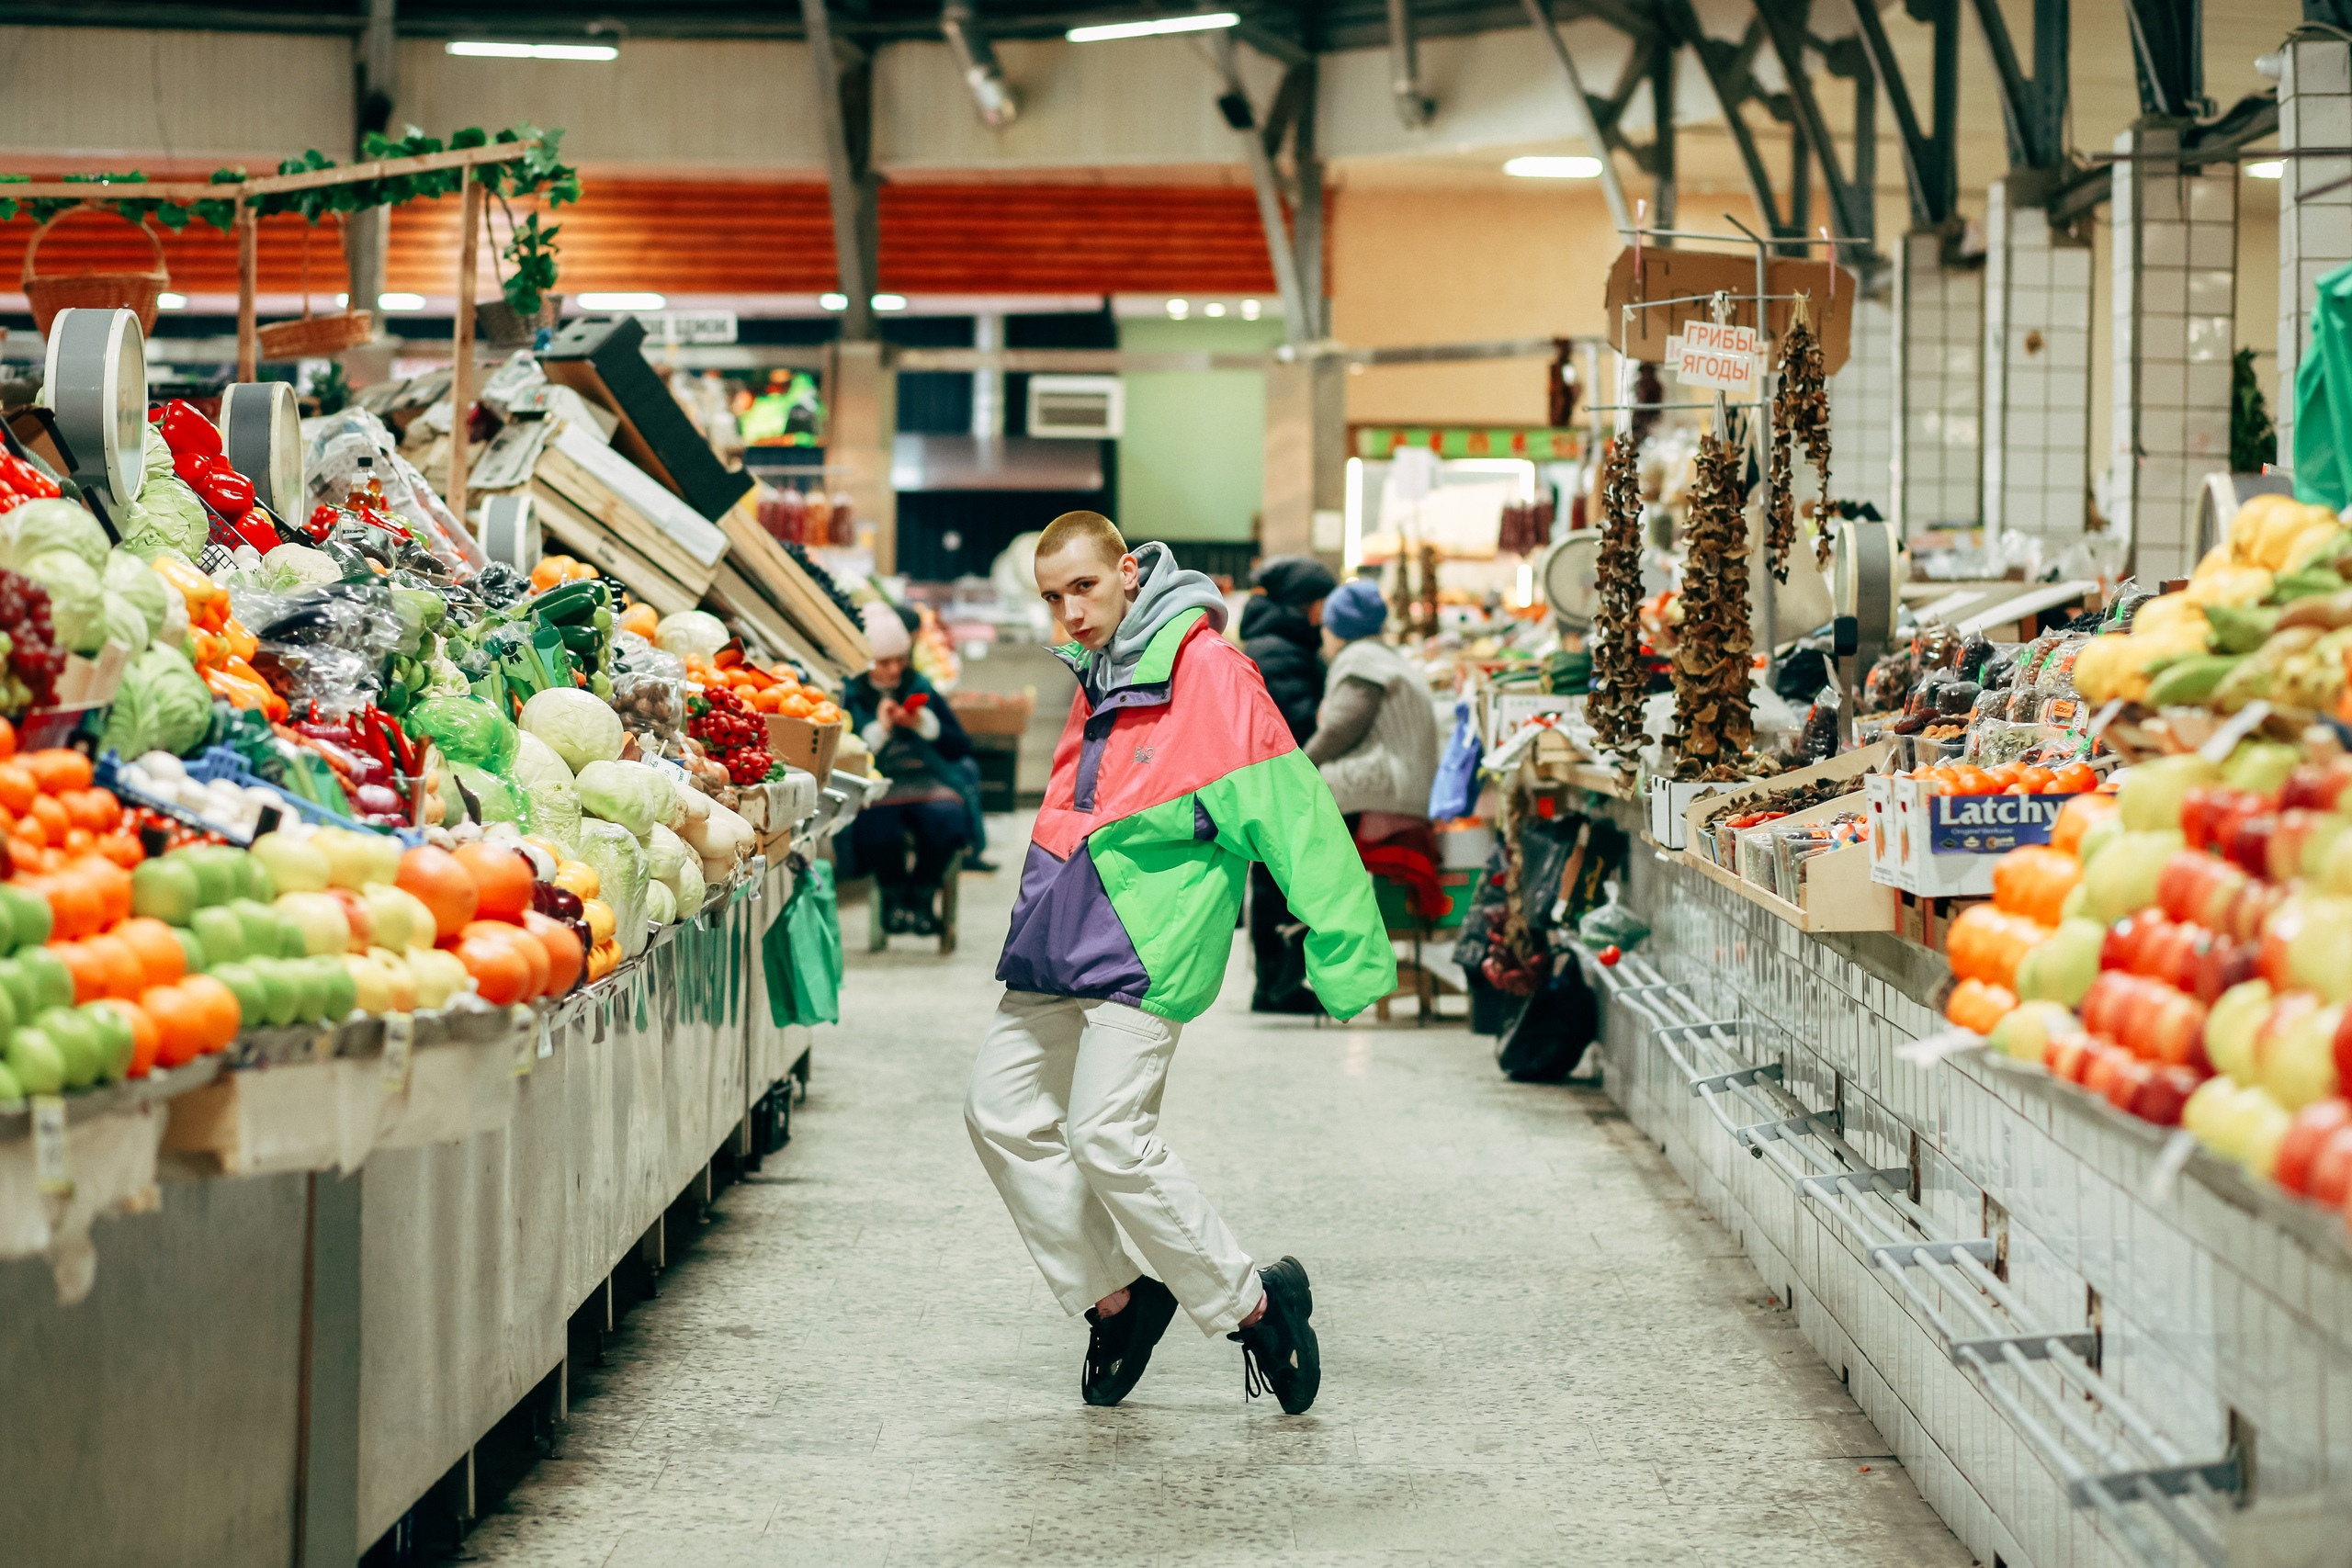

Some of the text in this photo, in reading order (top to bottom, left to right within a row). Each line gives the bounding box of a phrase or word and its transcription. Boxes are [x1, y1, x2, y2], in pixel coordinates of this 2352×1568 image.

[1687, 324, 1755, 353] ГРИБЫ
[1681, 354, 1750, 382] ЯГОДЫ
[1939, 794, 2065, 831] Latchy
